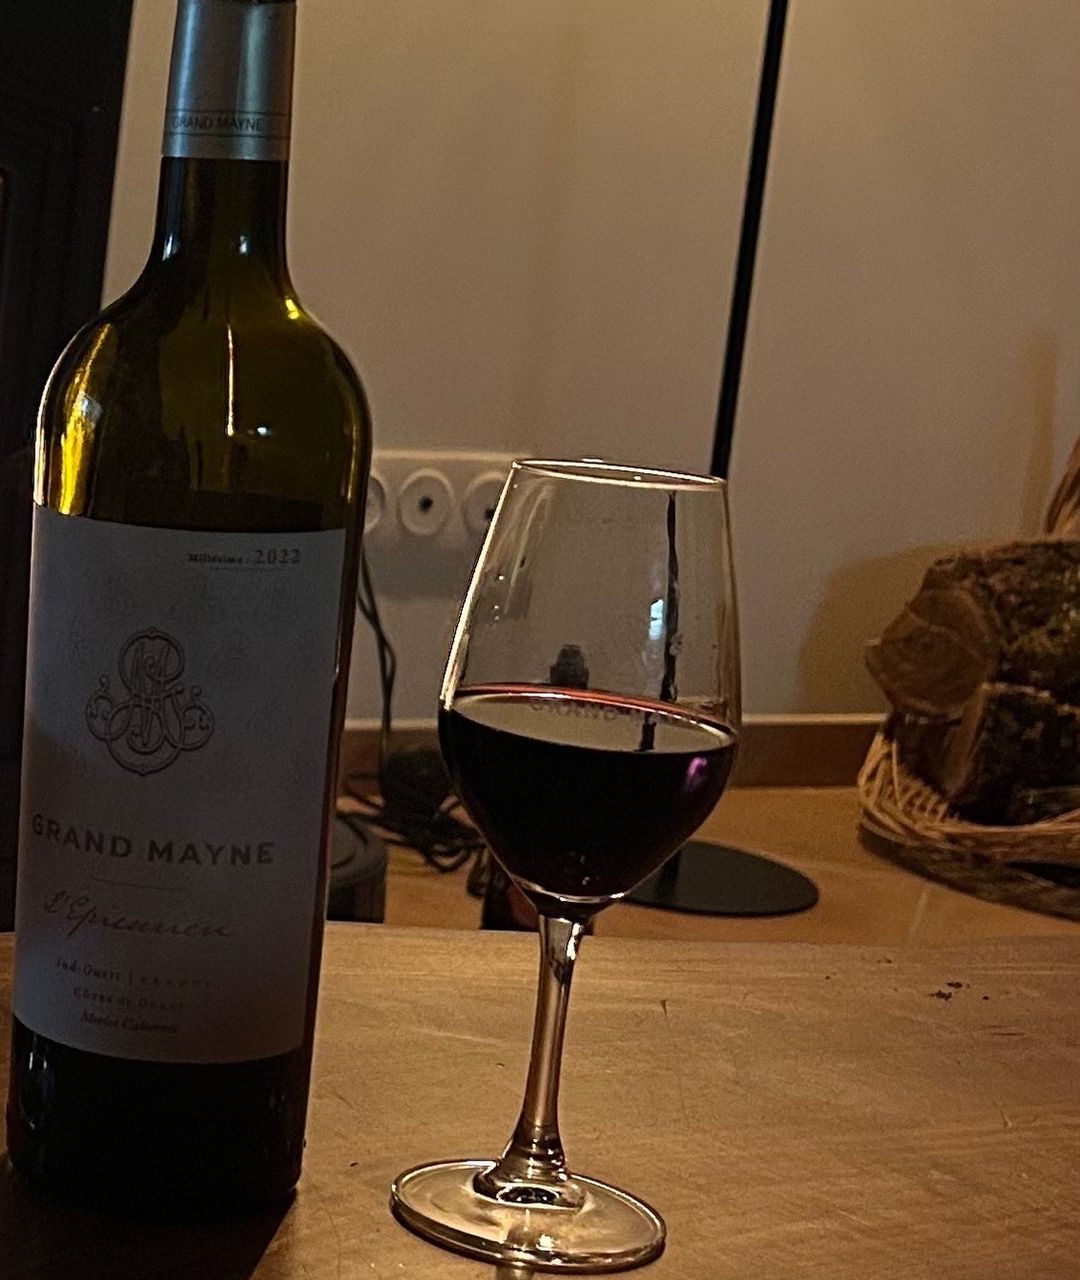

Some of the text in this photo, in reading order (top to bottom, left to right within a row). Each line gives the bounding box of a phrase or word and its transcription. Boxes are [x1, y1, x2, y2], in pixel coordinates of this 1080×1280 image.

[172, 113, 262, 132] GRAND MAYNE
[253, 548, 301, 565] 2022
[31, 813, 275, 866] GRAND MAYNE
